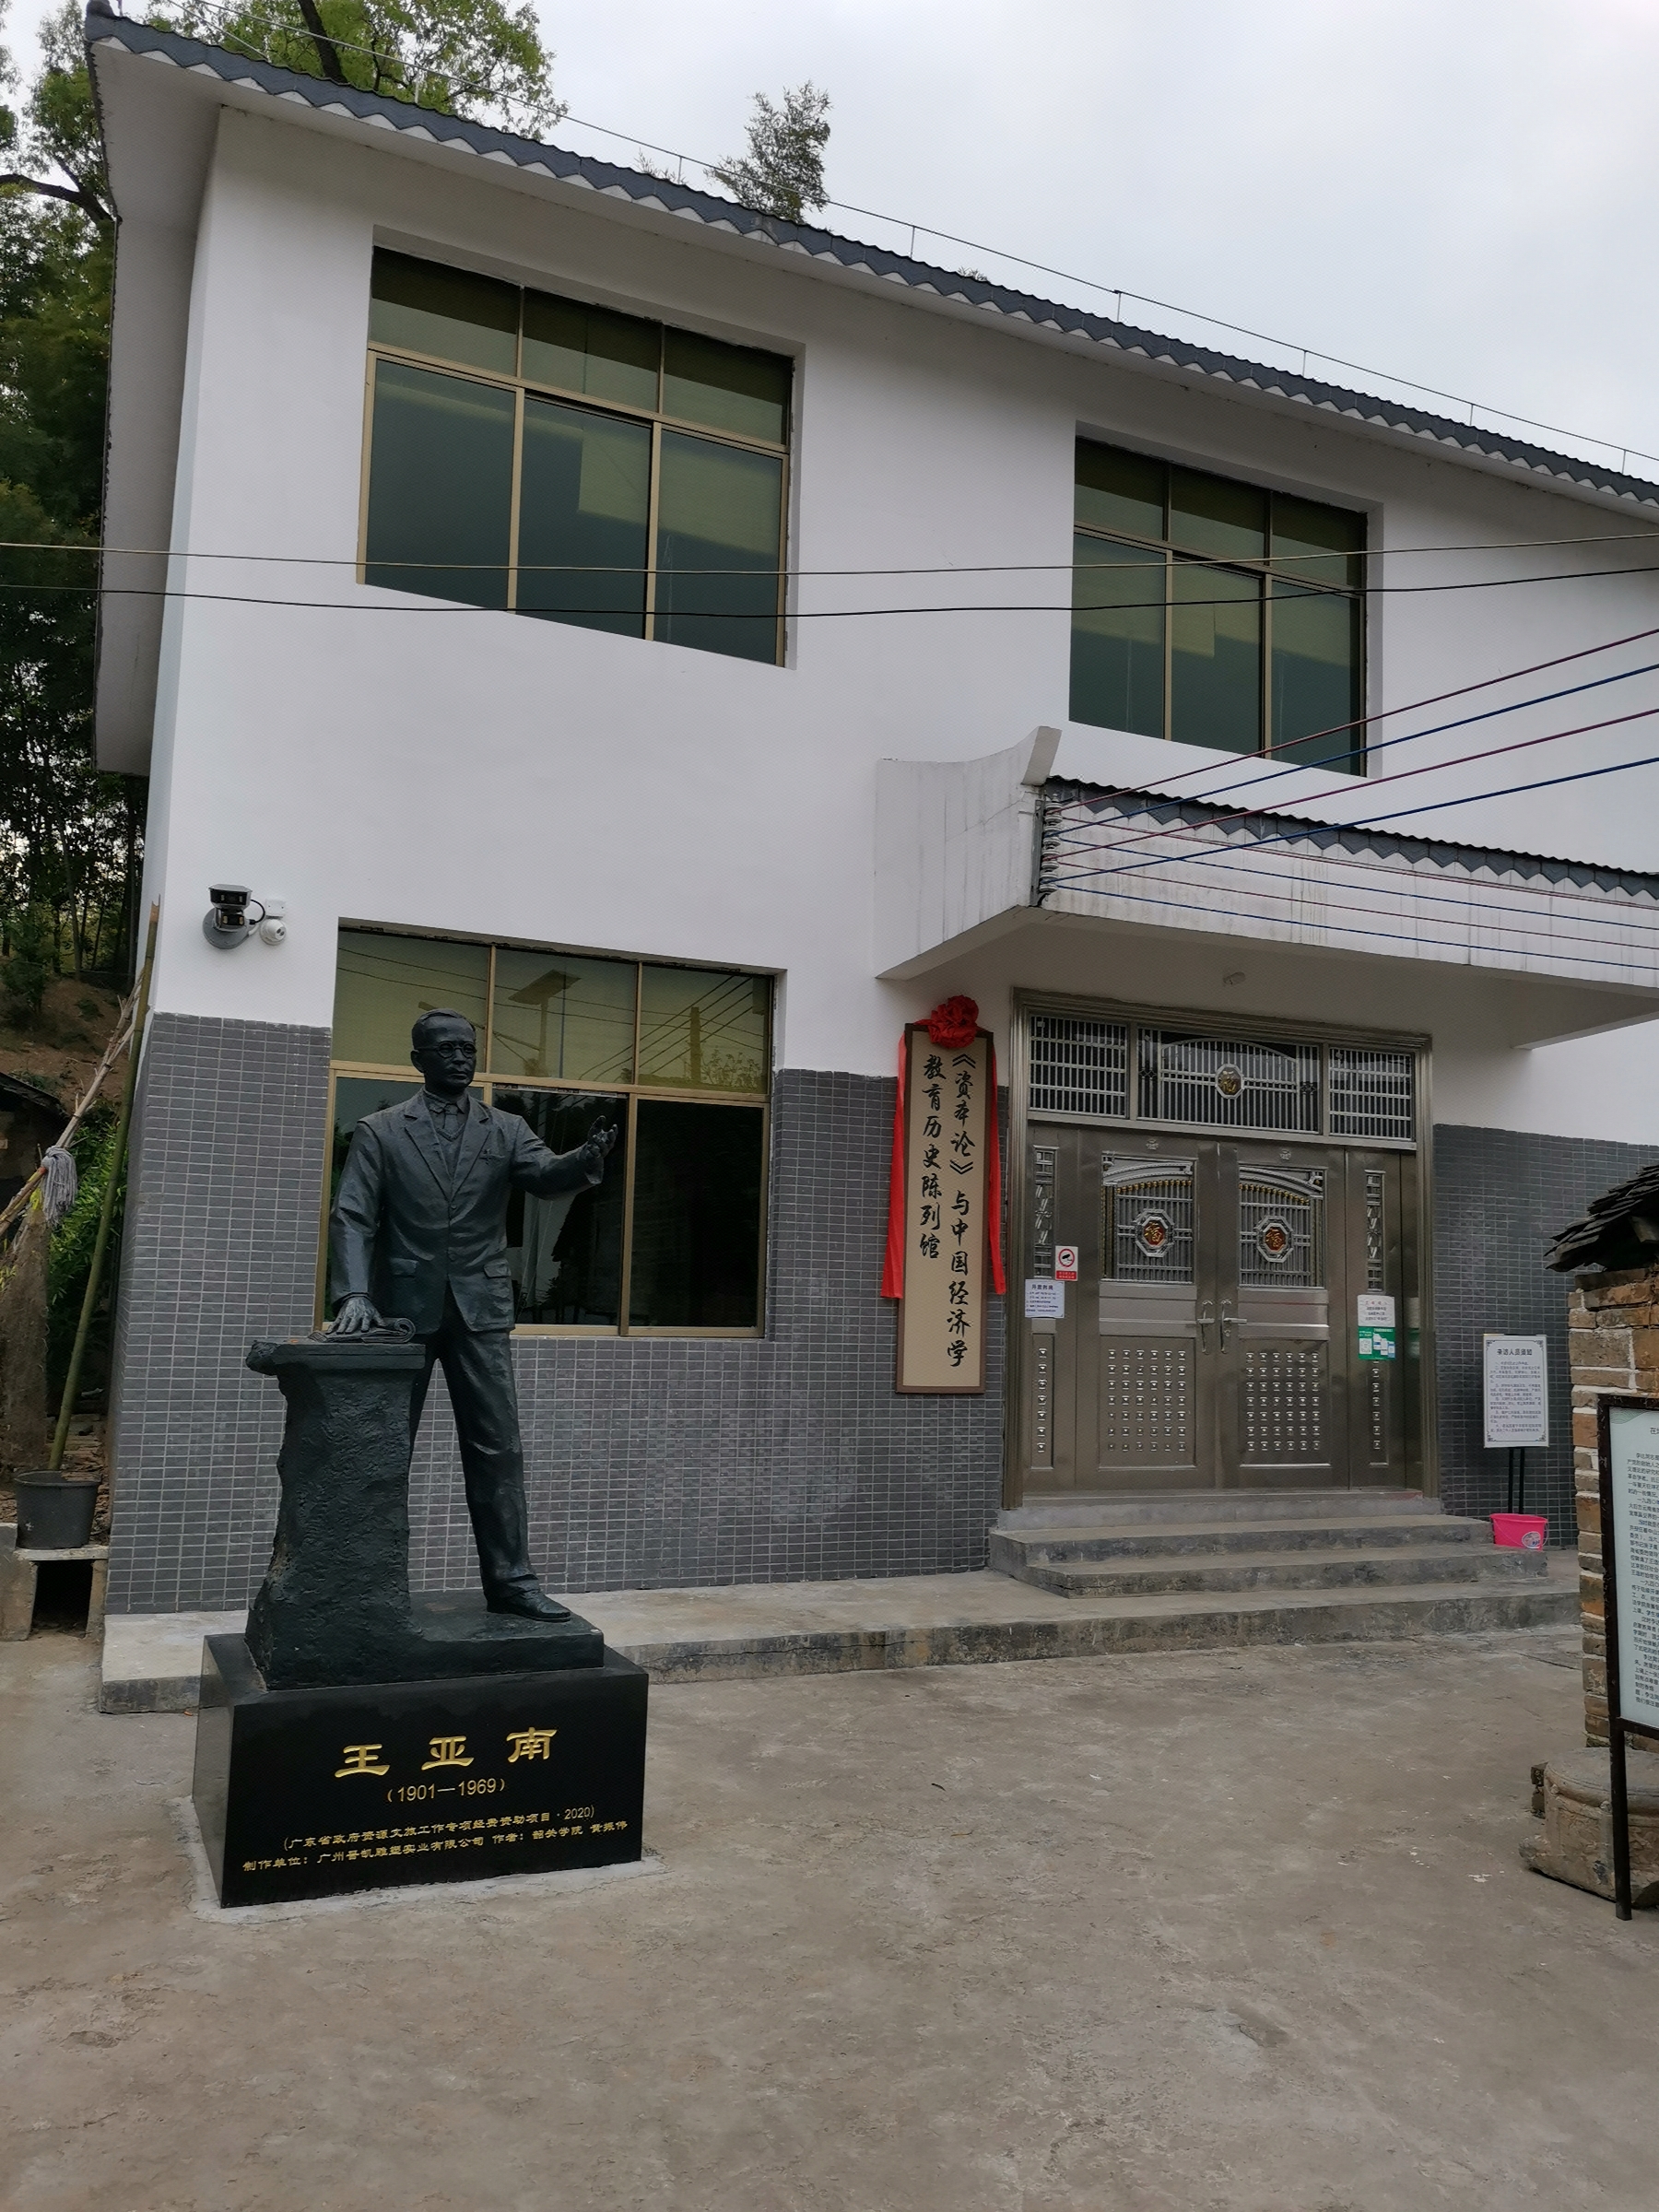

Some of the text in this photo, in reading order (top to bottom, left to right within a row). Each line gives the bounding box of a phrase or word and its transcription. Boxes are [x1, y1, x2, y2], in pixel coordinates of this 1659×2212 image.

[920, 1053, 946, 1260] 教育历史陈列馆
[335, 1727, 558, 1778] 王亚南
